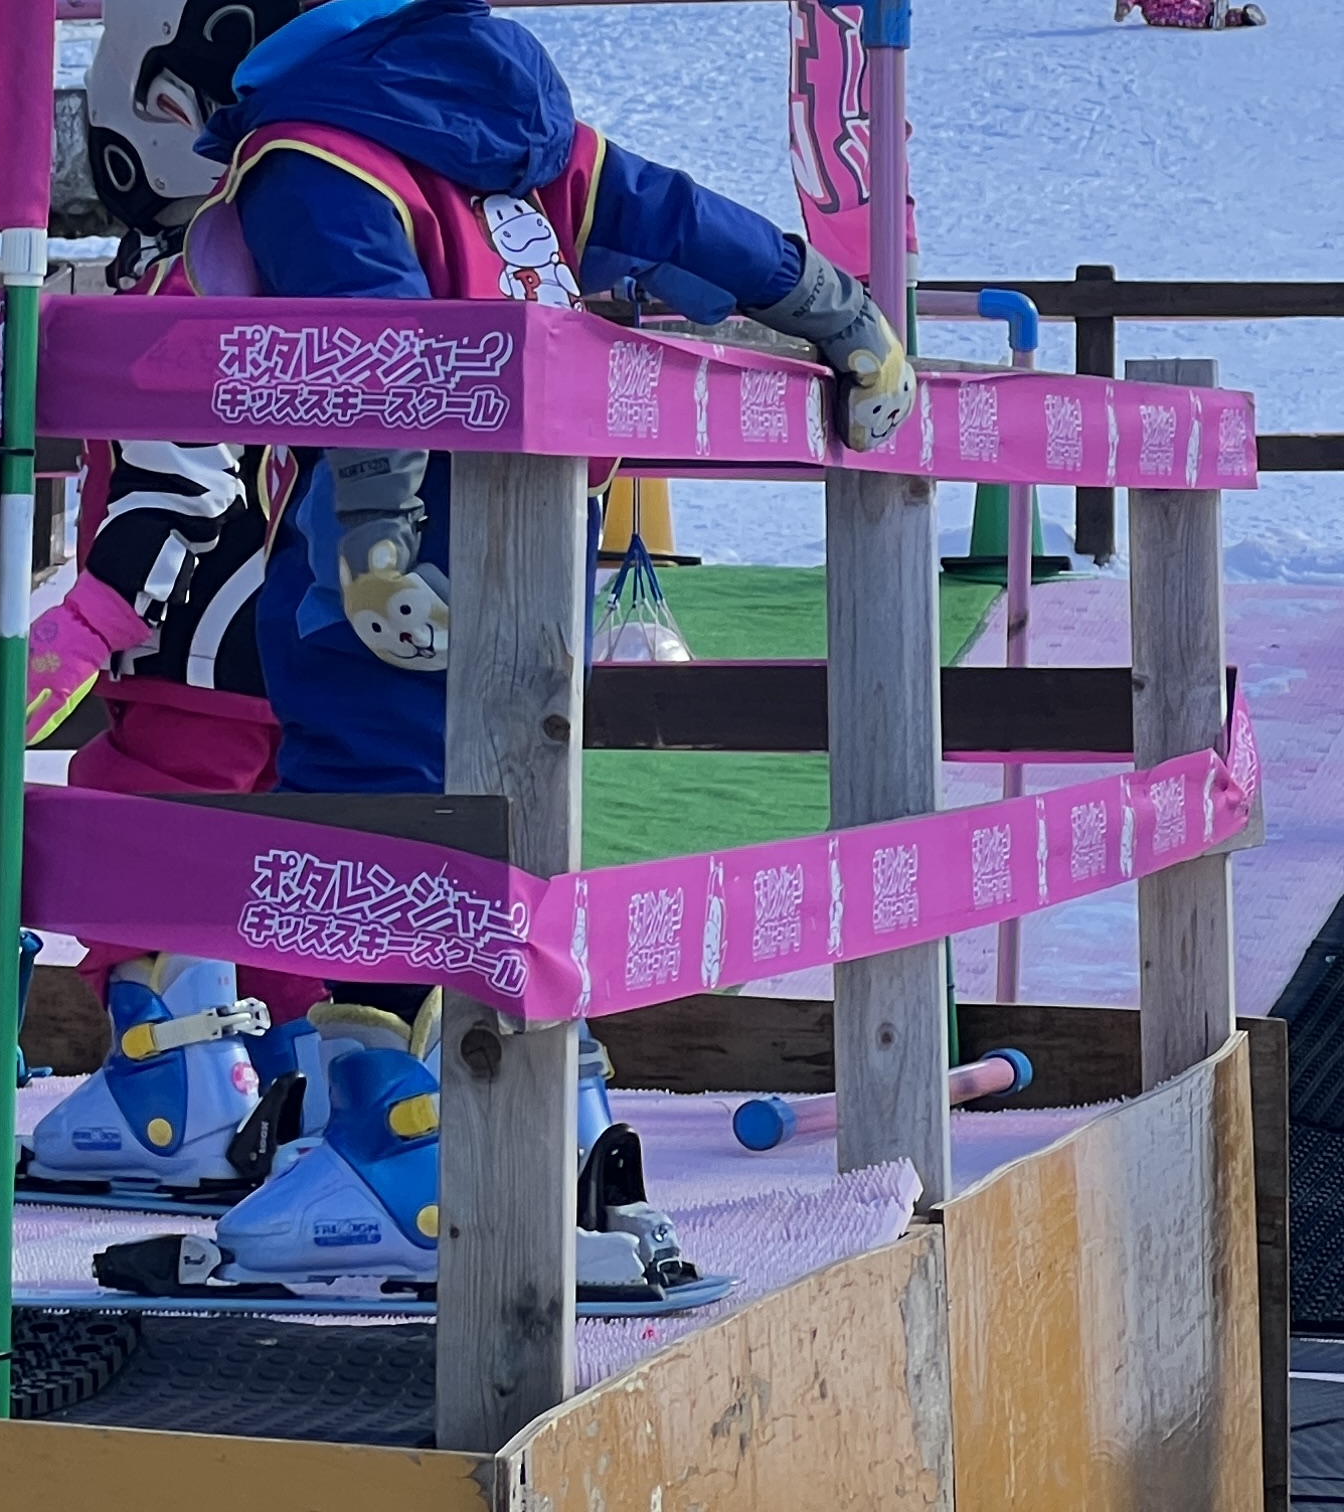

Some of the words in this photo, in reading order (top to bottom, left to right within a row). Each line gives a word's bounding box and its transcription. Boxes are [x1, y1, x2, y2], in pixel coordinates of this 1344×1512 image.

[219, 325, 514, 393] ポタレンジャー
[212, 377, 512, 432] キッズスキースクール
[251, 849, 530, 944] ポタレンジャー
[238, 899, 529, 997] キッズスキースクール
